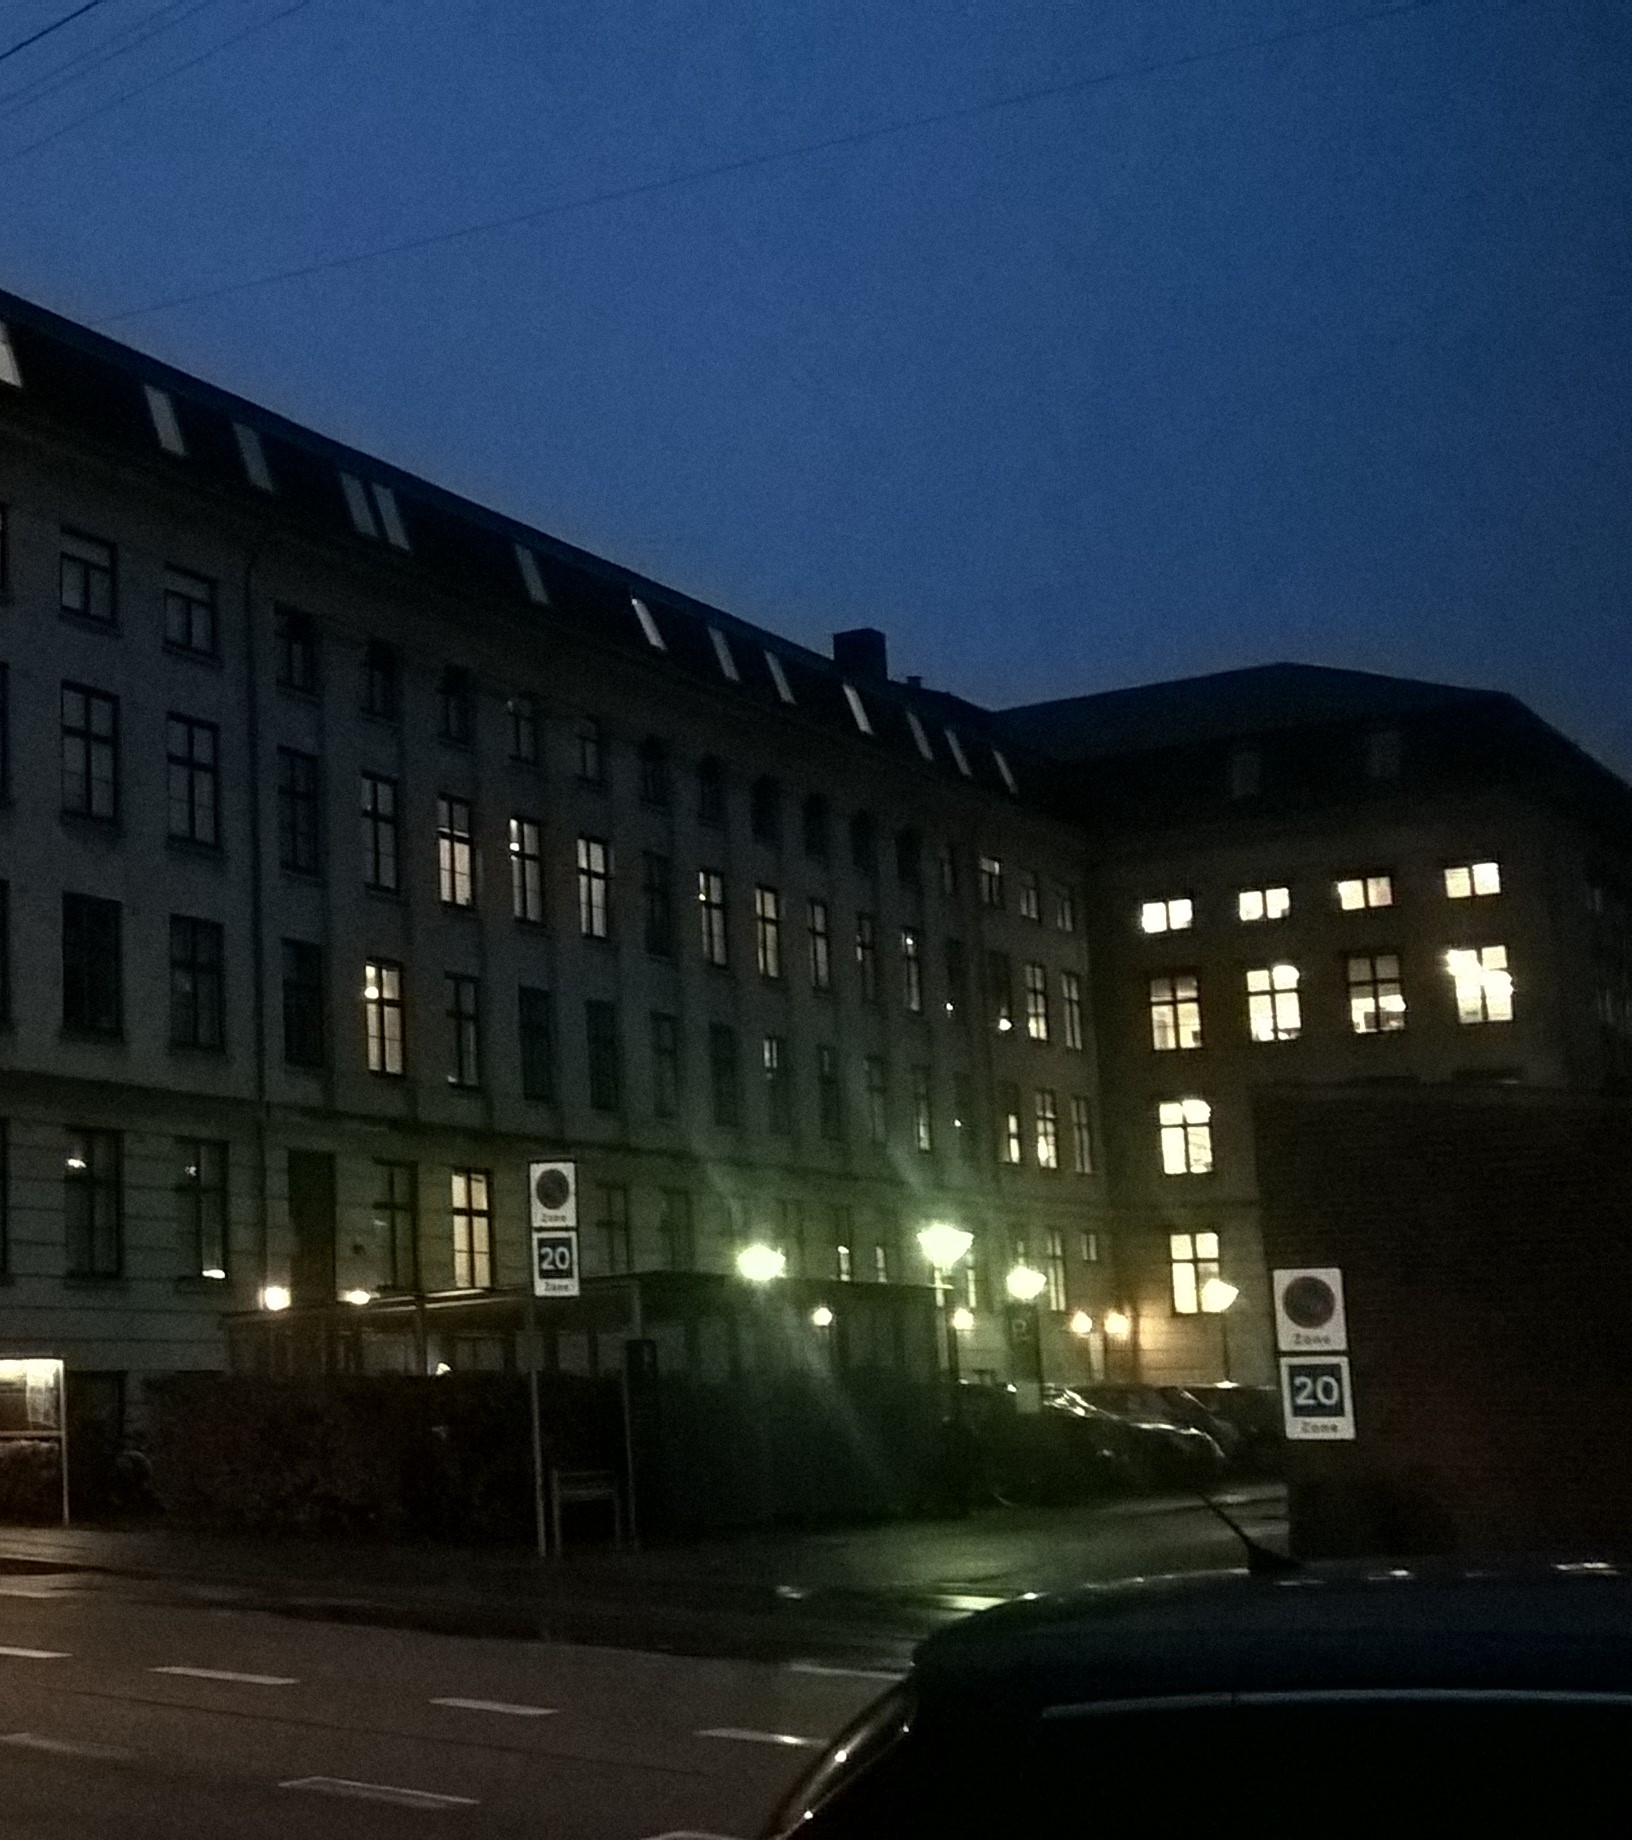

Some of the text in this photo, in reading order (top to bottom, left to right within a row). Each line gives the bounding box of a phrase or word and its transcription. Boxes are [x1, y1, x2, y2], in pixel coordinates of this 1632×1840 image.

[540, 1246, 570, 1270] 20
[1293, 1333, 1331, 1345] Zone
[1293, 1375, 1339, 1406] 20
